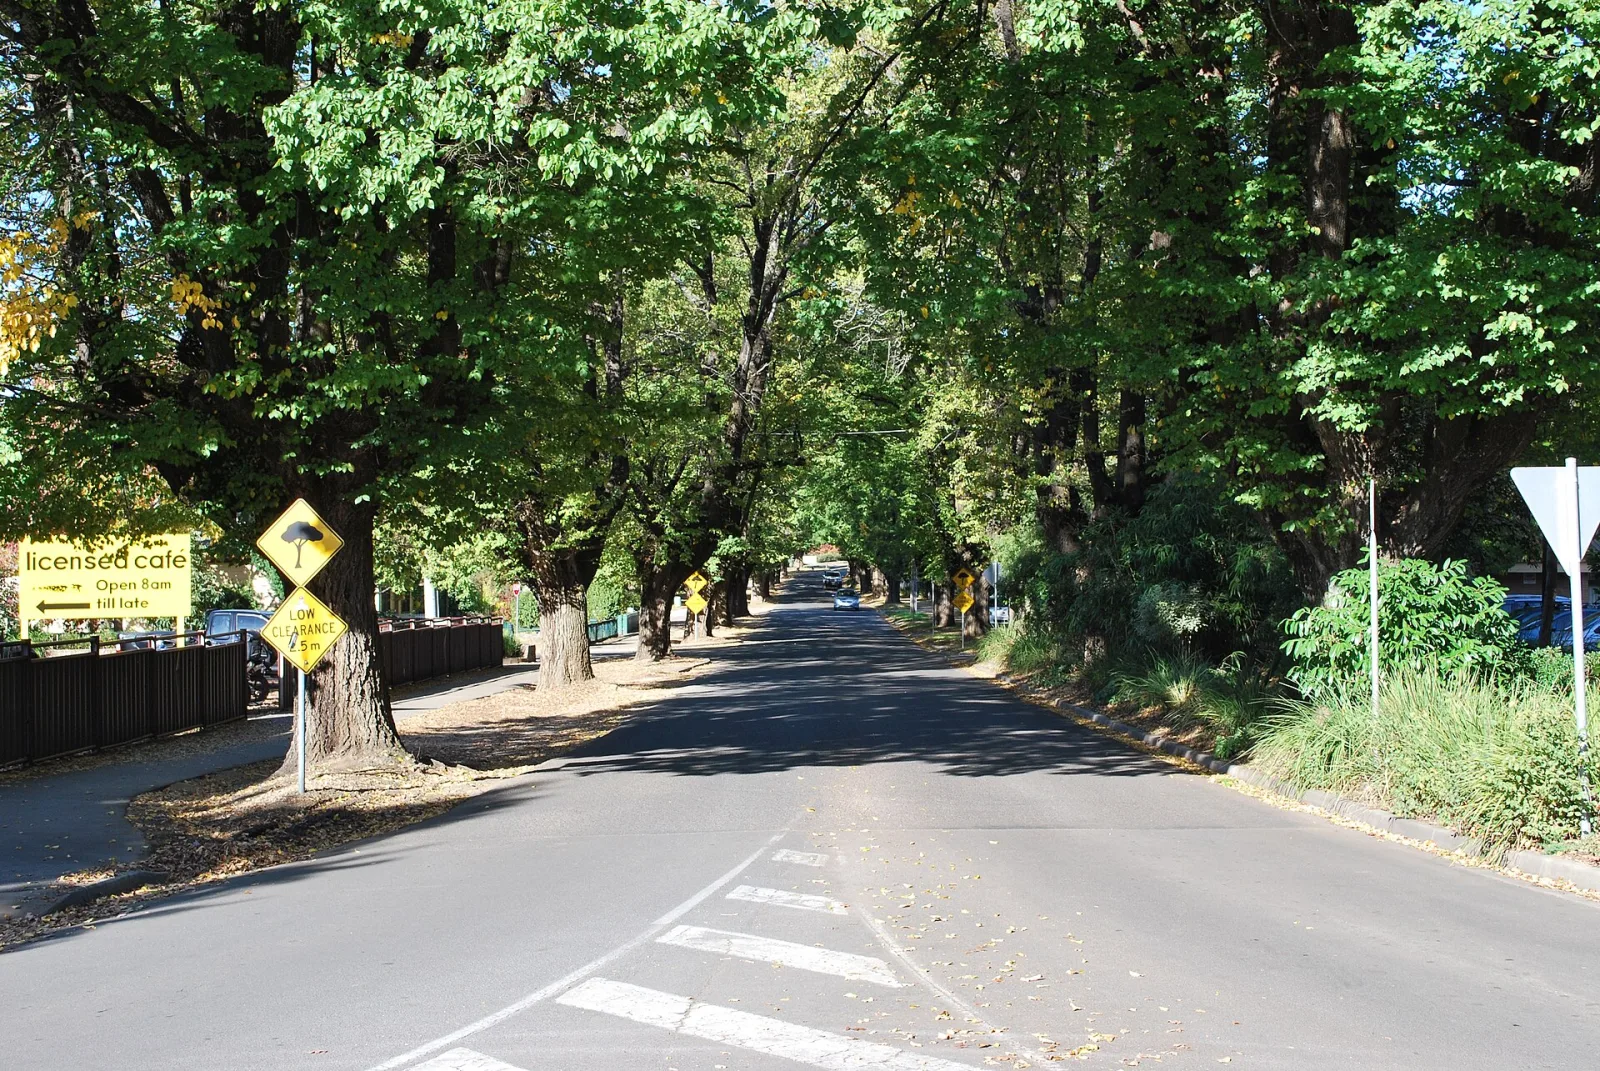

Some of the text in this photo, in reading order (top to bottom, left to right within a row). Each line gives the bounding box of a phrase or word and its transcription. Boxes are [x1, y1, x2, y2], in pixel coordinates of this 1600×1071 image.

[26, 549, 187, 571] licensed café
[96, 578, 172, 594] Open 8am
[97, 597, 149, 609] till late
[289, 608, 315, 621] LOW
[272, 622, 336, 638] CLEARANCE
[310, 642, 321, 651] m
